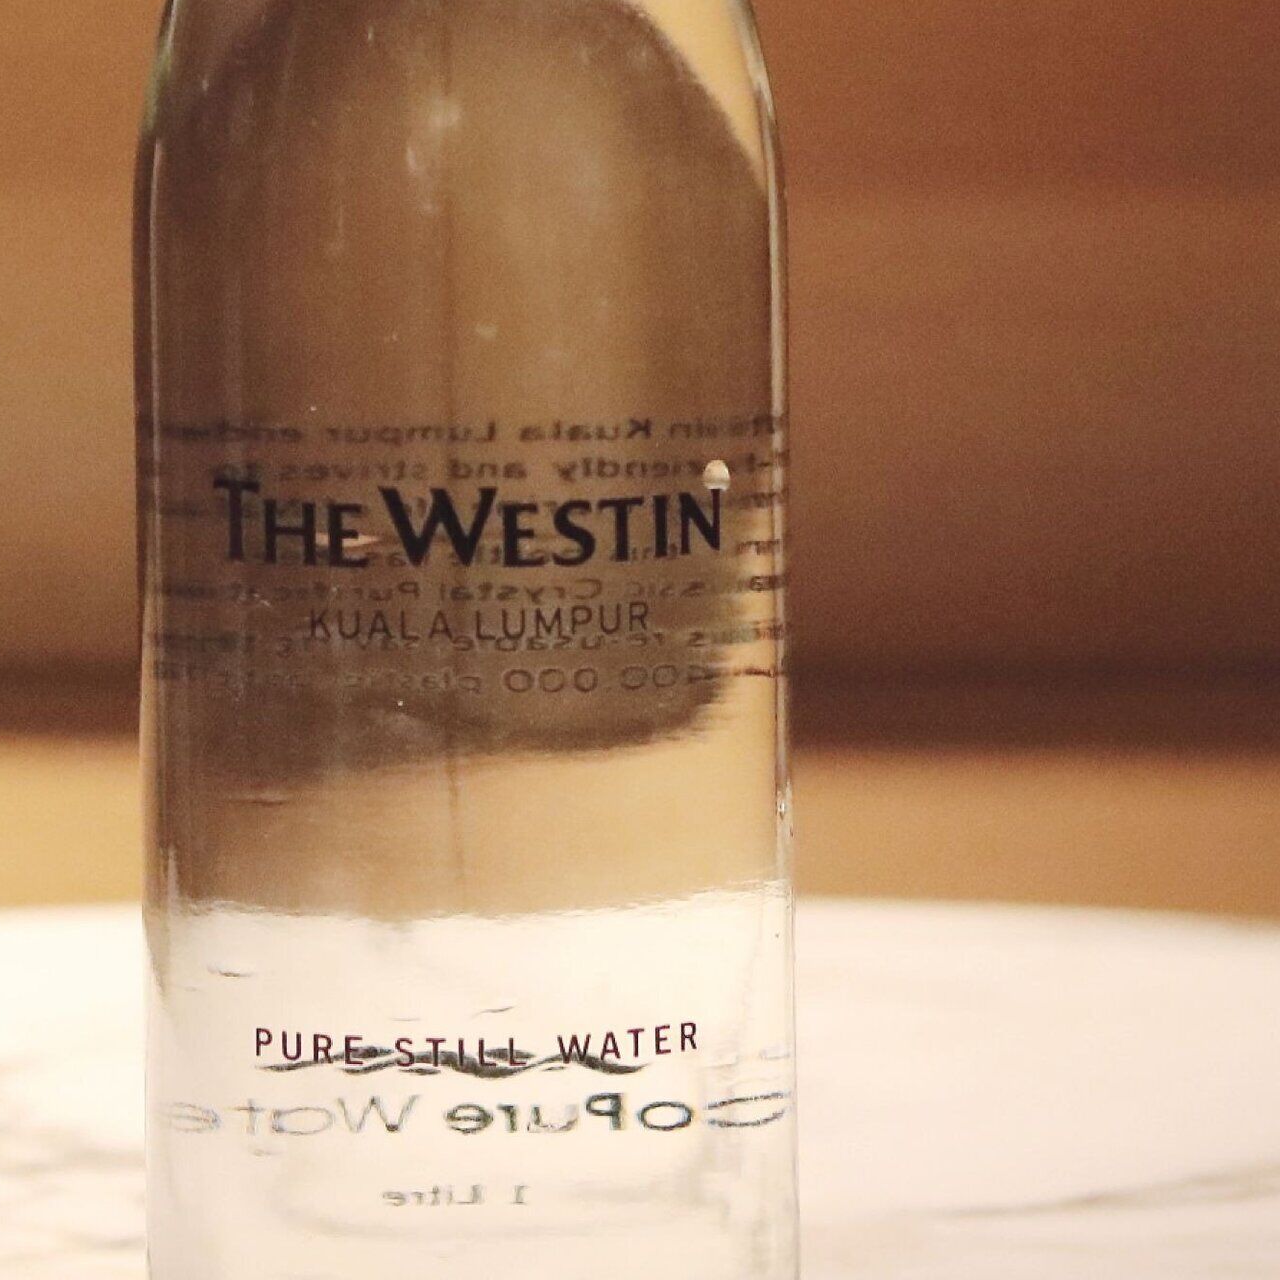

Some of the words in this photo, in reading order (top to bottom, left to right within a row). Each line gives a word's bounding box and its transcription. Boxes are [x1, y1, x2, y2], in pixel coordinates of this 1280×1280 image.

[212, 475, 368, 568] THE
[377, 486, 721, 569] WESTIN
[306, 606, 455, 643] KUALA
[476, 601, 651, 639] LUMPUR
[254, 1027, 364, 1065] PURE
[395, 1037, 528, 1068] STILL
[558, 1022, 699, 1064] WATER
